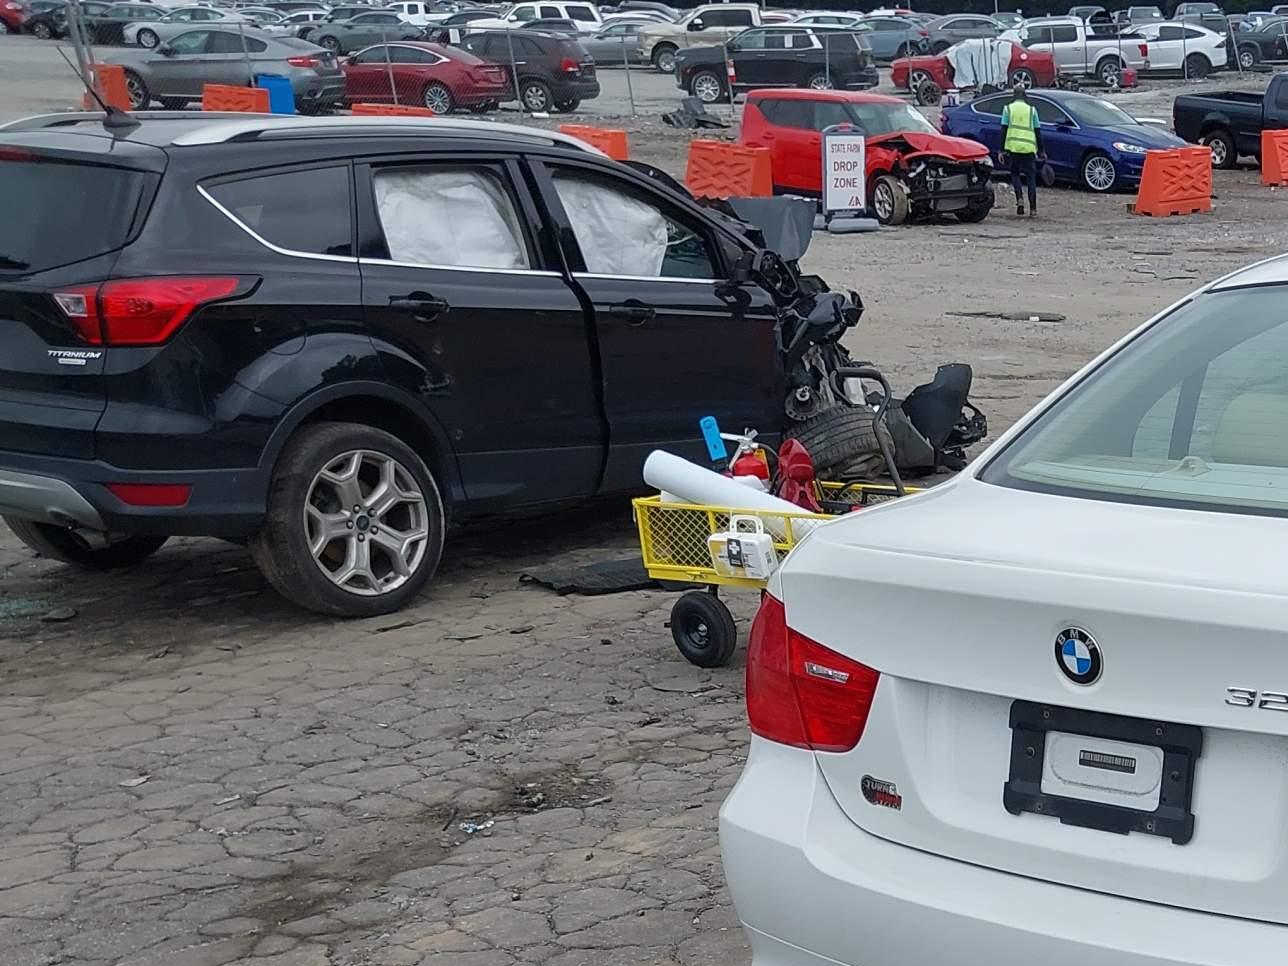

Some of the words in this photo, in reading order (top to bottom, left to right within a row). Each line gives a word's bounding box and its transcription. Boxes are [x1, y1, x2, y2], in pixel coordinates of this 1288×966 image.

[831, 144, 845, 153] STATE
[833, 161, 858, 172] DROP
[834, 178, 857, 188] ZONE
[47, 350, 102, 359] TITANIUM
[1057, 629, 1095, 650] BMW
